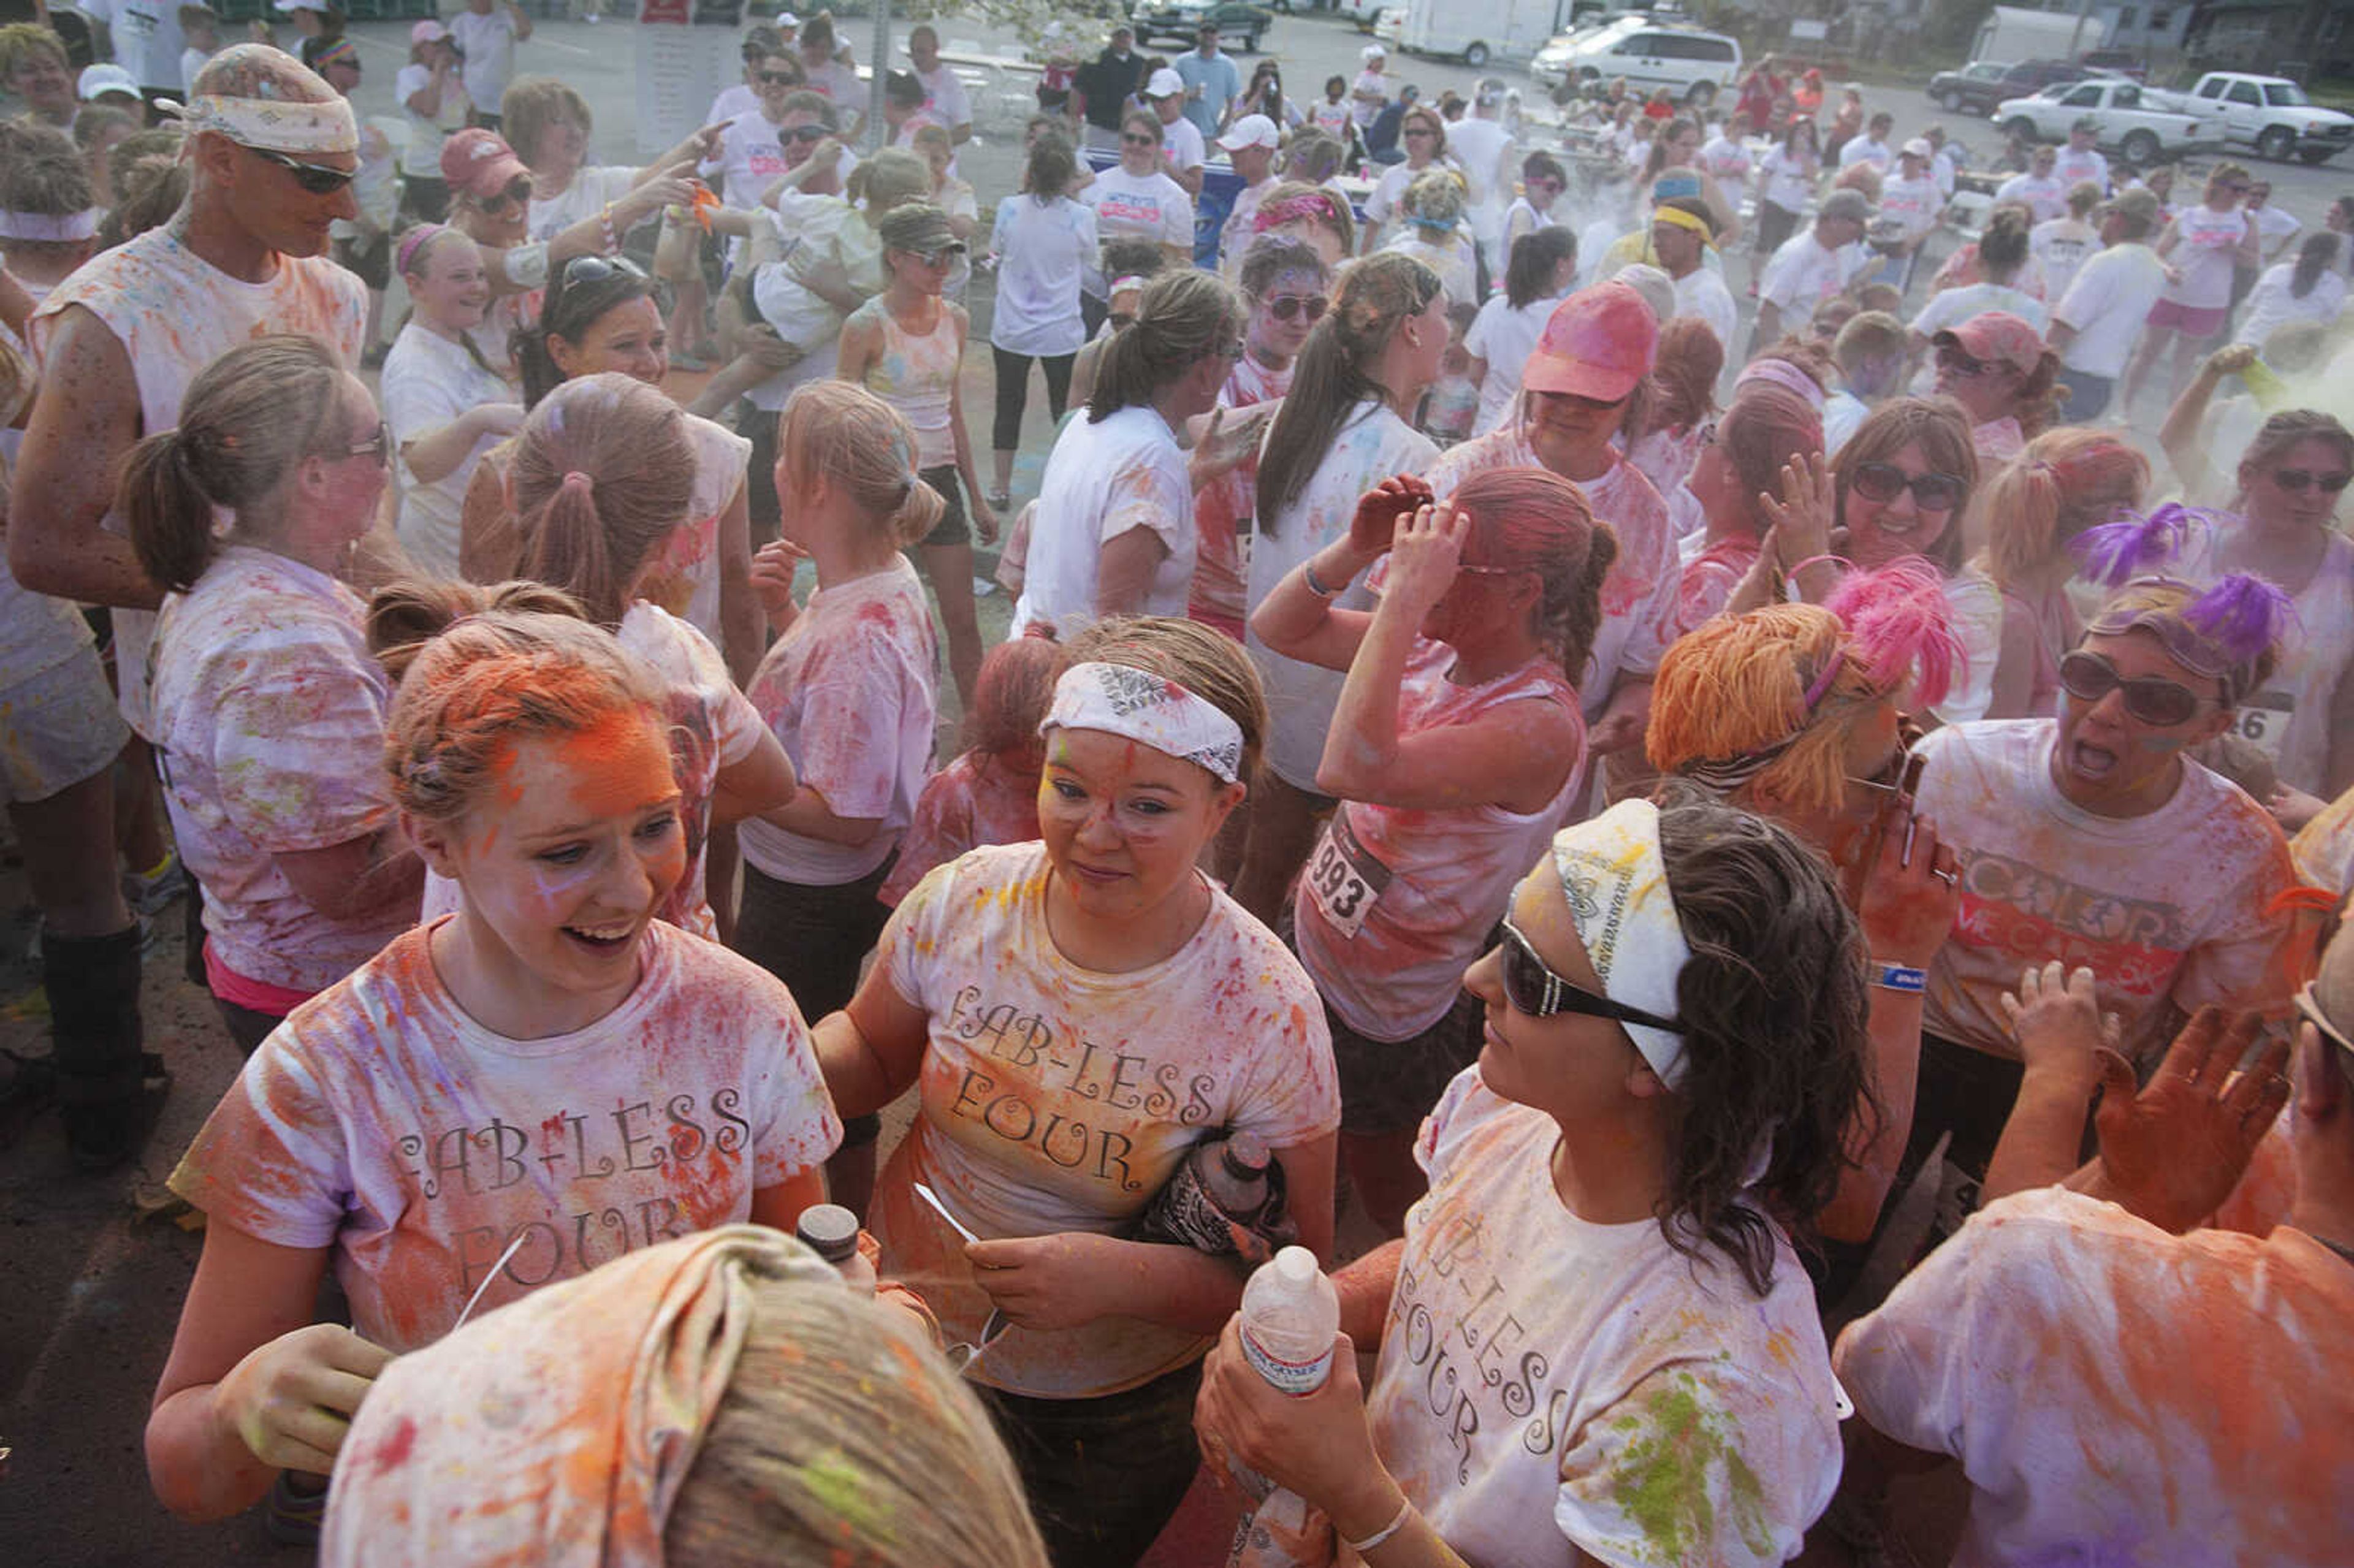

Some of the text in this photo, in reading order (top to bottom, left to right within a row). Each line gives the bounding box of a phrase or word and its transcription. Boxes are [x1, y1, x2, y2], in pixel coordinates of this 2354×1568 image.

[1313, 845, 1365, 918] 993
[947, 985, 1215, 1126] FAB-LESS
[951, 1067, 1143, 1192] FOUR
[1392, 1267, 1479, 1486] FOUR
